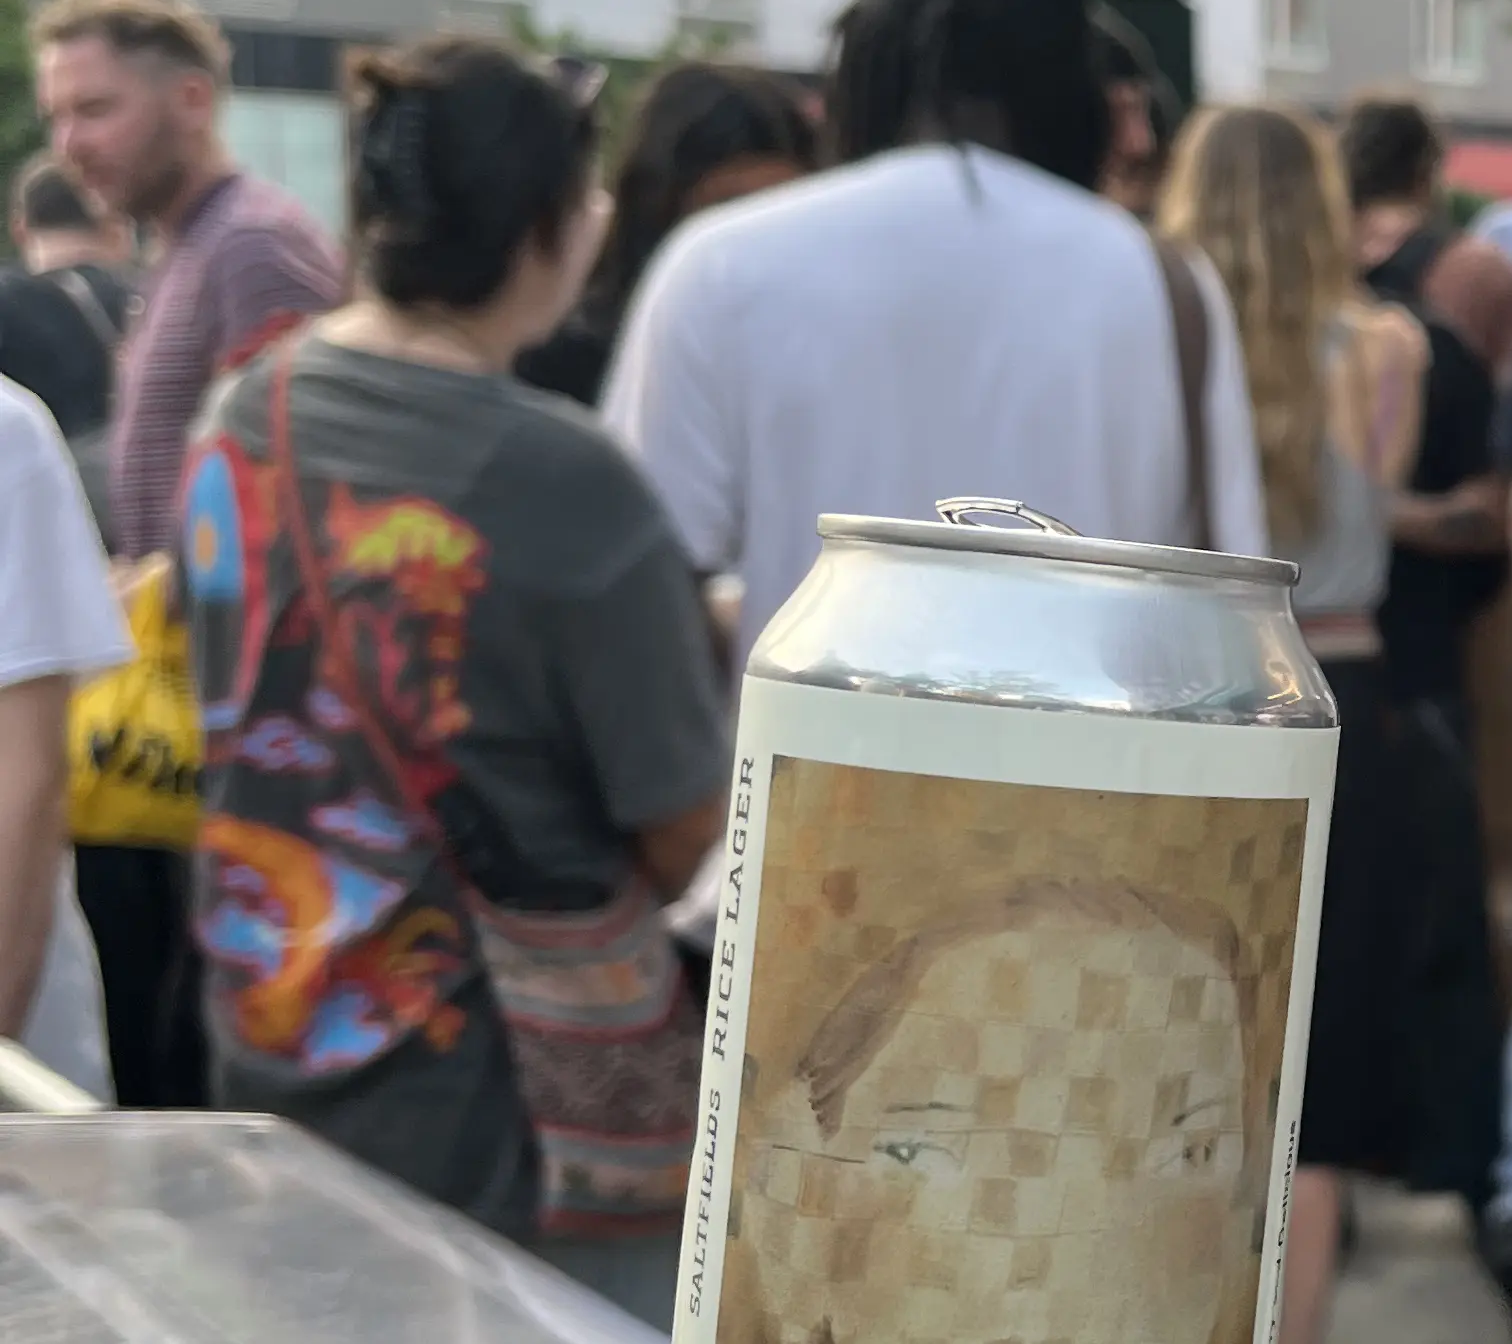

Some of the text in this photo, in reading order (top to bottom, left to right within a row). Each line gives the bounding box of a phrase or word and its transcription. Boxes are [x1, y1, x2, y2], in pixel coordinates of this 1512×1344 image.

[689, 757, 755, 1317] SALTFIELDS RICE LAGER
